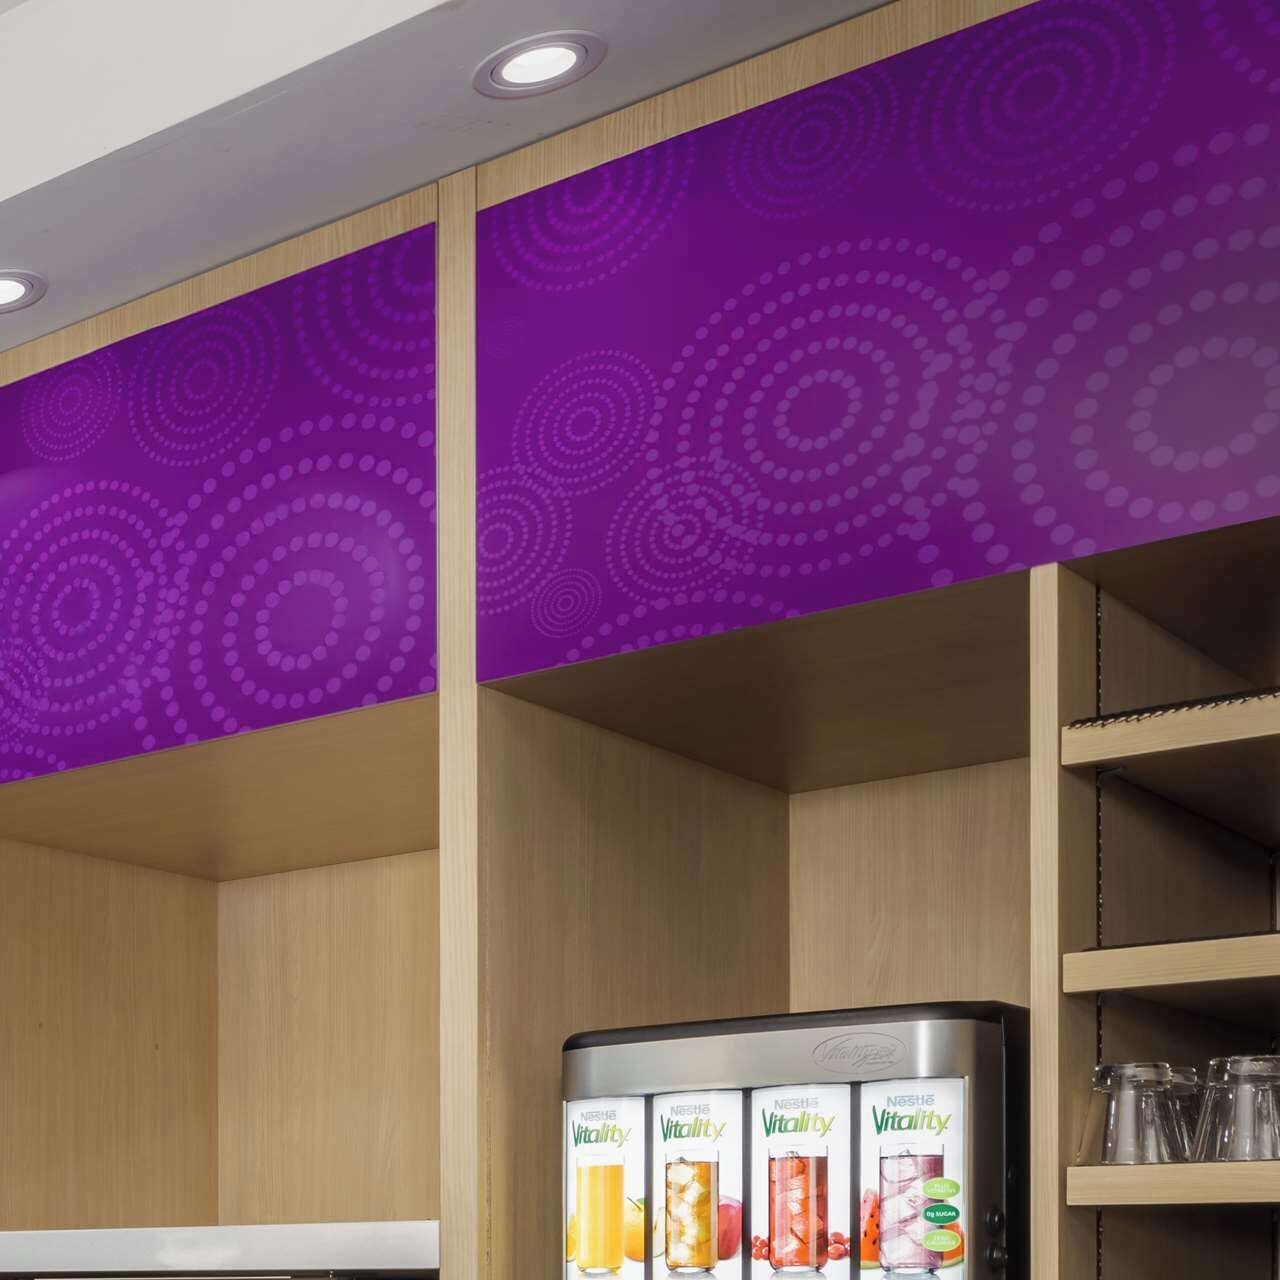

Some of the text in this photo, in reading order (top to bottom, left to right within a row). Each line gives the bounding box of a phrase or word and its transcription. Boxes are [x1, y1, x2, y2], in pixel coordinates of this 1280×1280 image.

[669, 1103, 711, 1117] Nestlé
[774, 1097, 819, 1110] Nestlé
[886, 1094, 936, 1108] Nestlé
[580, 1109, 617, 1122] Nestlé
[761, 1107, 836, 1138] Vitality
[872, 1104, 952, 1136] Vitality
[572, 1120, 632, 1149] Vitality
[660, 1113, 727, 1143] Vitality
